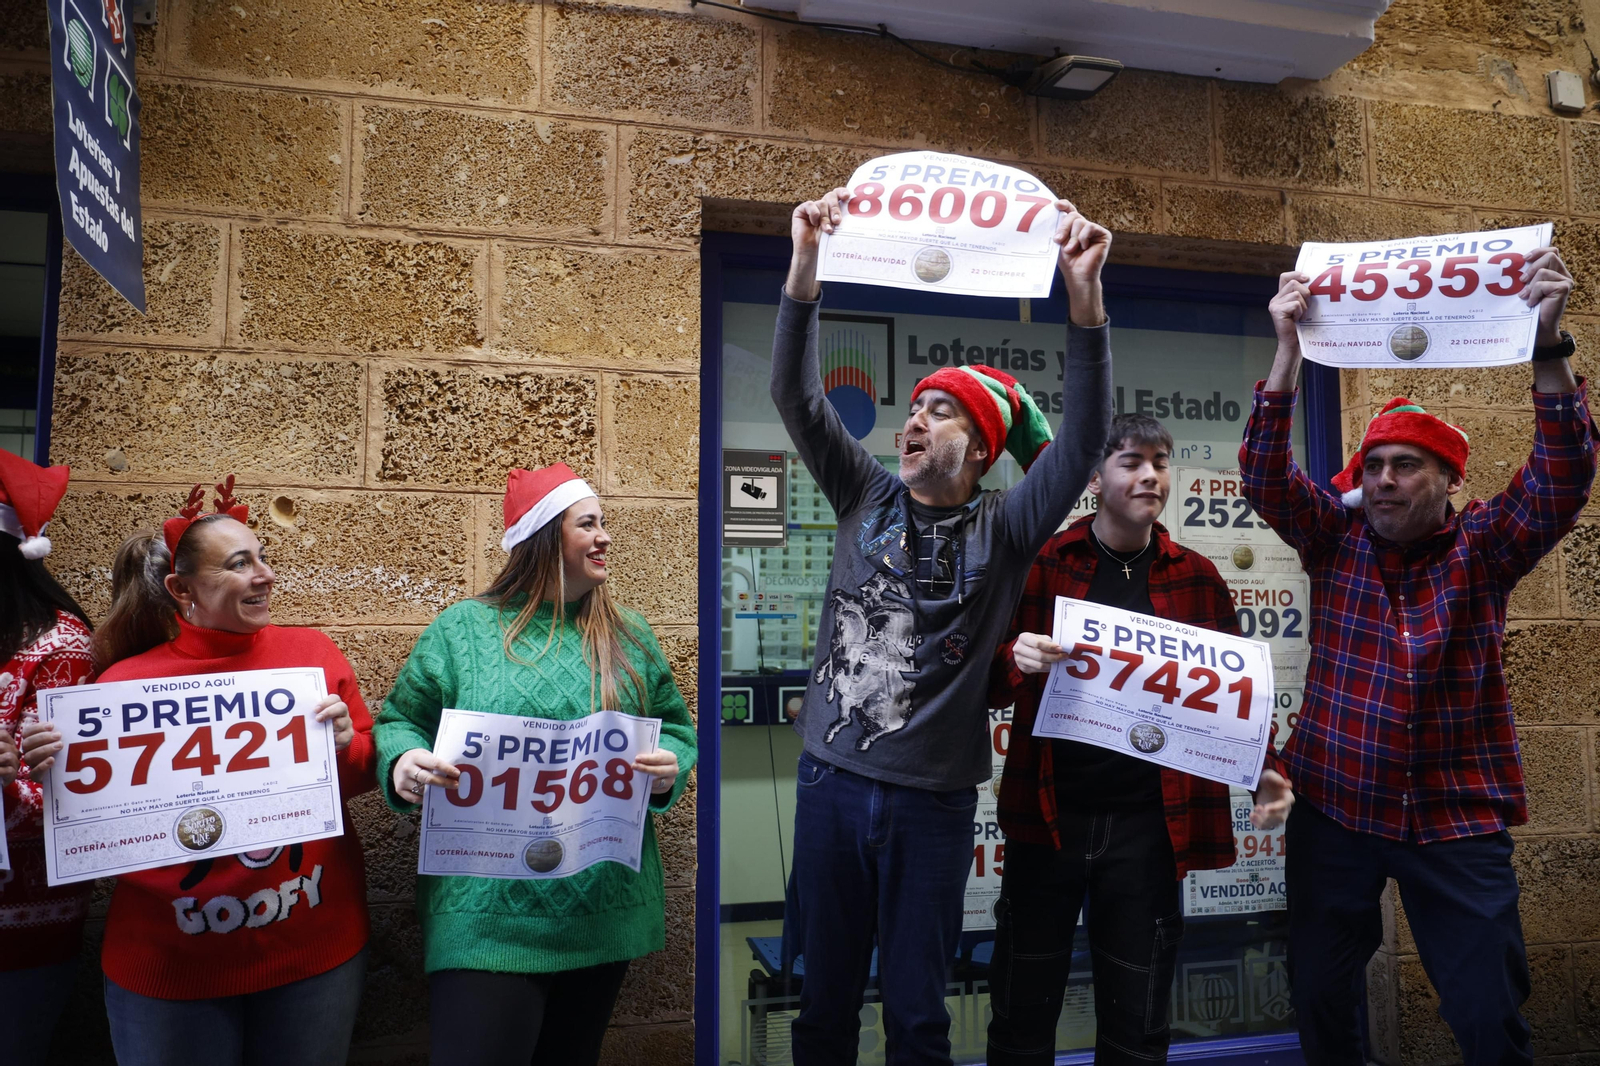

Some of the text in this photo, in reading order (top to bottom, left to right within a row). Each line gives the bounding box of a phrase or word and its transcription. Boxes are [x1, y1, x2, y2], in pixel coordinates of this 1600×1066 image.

[68, 101, 121, 194] Loterías y
[923, 154, 967, 165] VENDIDO
[869, 165, 1040, 193] 5º PREMIO
[68, 146, 135, 242] Apuestas del
[848, 182, 1051, 233] 86007
[70, 190, 108, 252] Estado
[1360, 239, 1513, 262] PREMIO
[1381, 239, 1428, 248] VENDIDO
[872, 257, 906, 265] NAVIDAD
[1308, 253, 1527, 302] 45353
[908, 335, 1046, 372] Loterías
[1135, 385, 1241, 422] Estado
[1204, 445, 1211, 460] 3
[1231, 589, 1293, 606] REMIO
[1130, 616, 1198, 637] VENDIDO AQUÍ
[1237, 608, 1302, 638] 092
[1082, 619, 1244, 672] 5º PREMIO
[143, 676, 235, 693] VENDIDO AQUÍ
[1066, 643, 1252, 720] 57421
[77, 688, 295, 736] 5º PREMIO
[1116, 706, 1134, 714] MAYOR
[1136, 713, 1154, 721] SUERTE
[1184, 725, 1211, 734] TENERNOS
[523, 720, 566, 731] VENDIDO
[1088, 719, 1122, 732] NAVIDAD
[64, 715, 309, 794] 57421
[462, 729, 628, 764] 5º PREMIO
[1195, 751, 1237, 765] DICIEMBRE
[445, 758, 633, 813] 01568
[149, 802, 173, 810] MAYOR
[175, 798, 200, 806] SUERTE
[237, 788, 270, 797] TENERNOS
[262, 809, 311, 822] DICIEMBRE
[66, 833, 166, 855] LOTERÍA de NAVIDAD
[587, 836, 622, 847] DICIEMBRE
[478, 851, 514, 859] NAVIDAD
[172, 864, 323, 935] GOOFY
[1200, 882, 1287, 898] VENDIDO AQ
